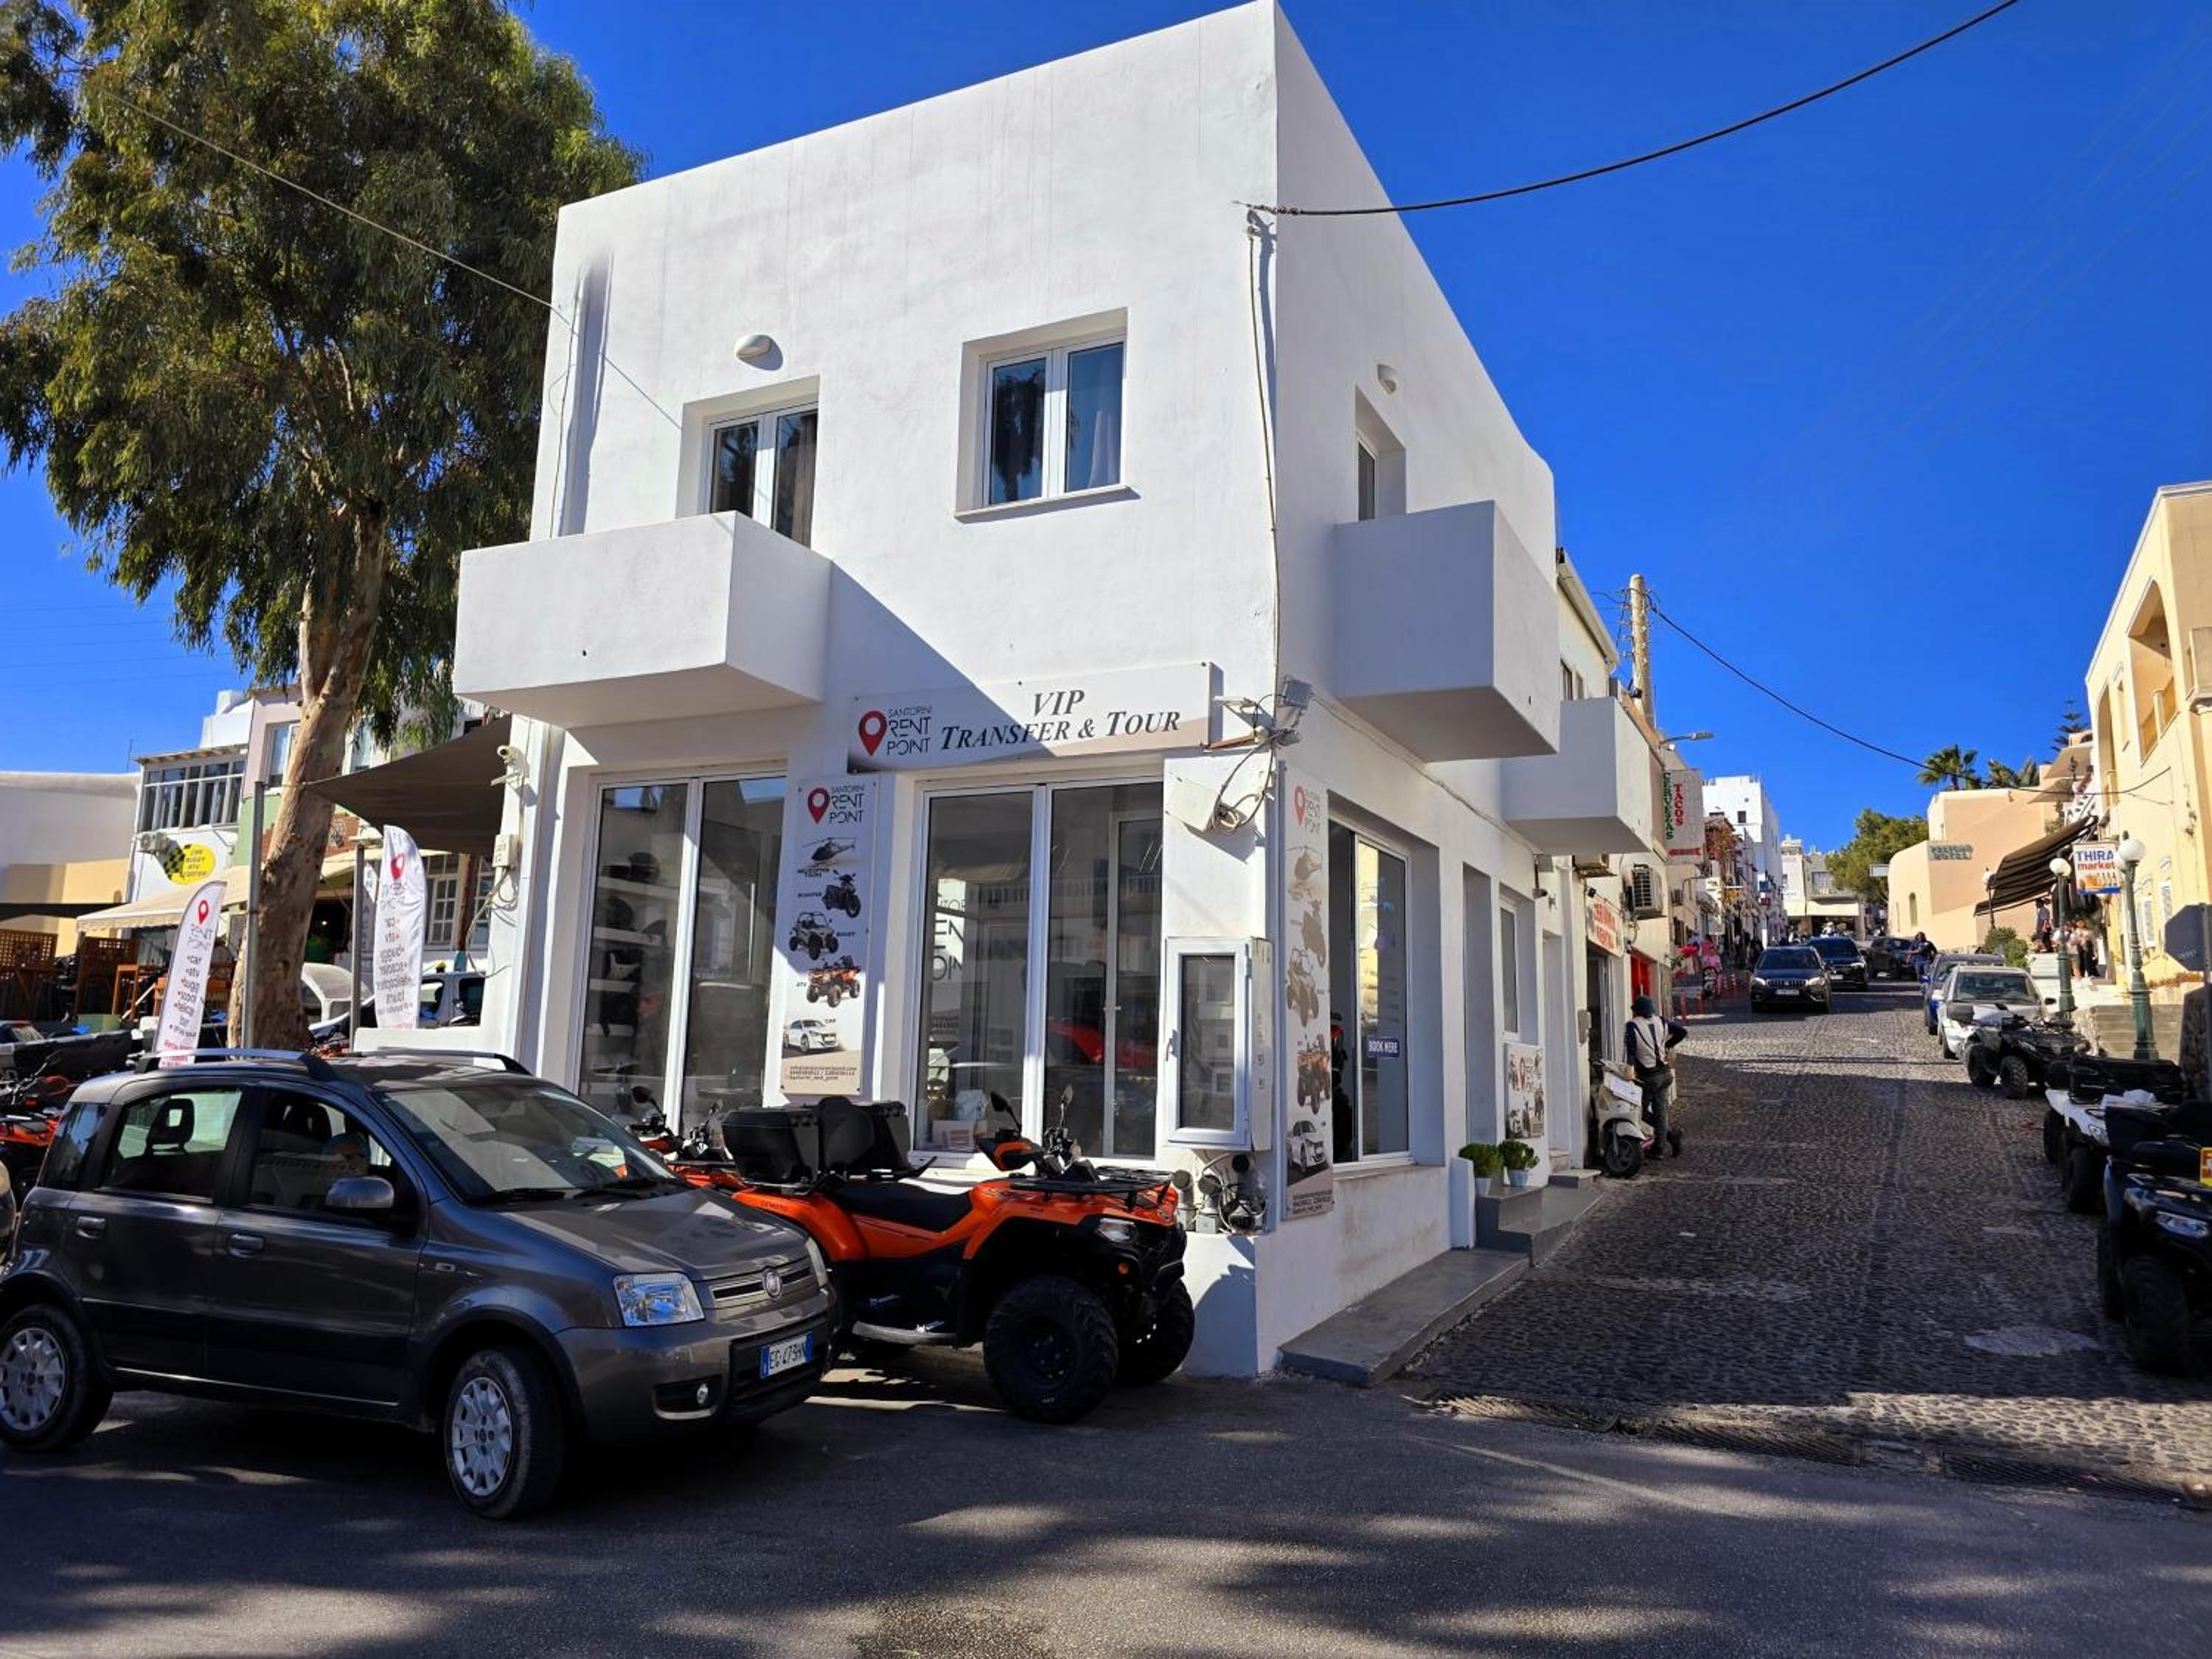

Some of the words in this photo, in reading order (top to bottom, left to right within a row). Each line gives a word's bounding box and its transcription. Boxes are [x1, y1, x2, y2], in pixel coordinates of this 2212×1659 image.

[1034, 690, 1085, 717] VIP
[888, 716, 931, 737] RENT
[942, 720, 1070, 750] TRANSFER
[1078, 719, 1096, 737] &
[1106, 711, 1180, 737] TOUR
[886, 737, 931, 756] POINT
[831, 793, 865, 810] RENT
[1673, 784, 1683, 827] TACOS
[2076, 850, 2114, 861] THIRA
[2077, 860, 2115, 870] market
[1369, 1040, 1383, 1052] BOOK
[1384, 1041, 1398, 1053] HERE
